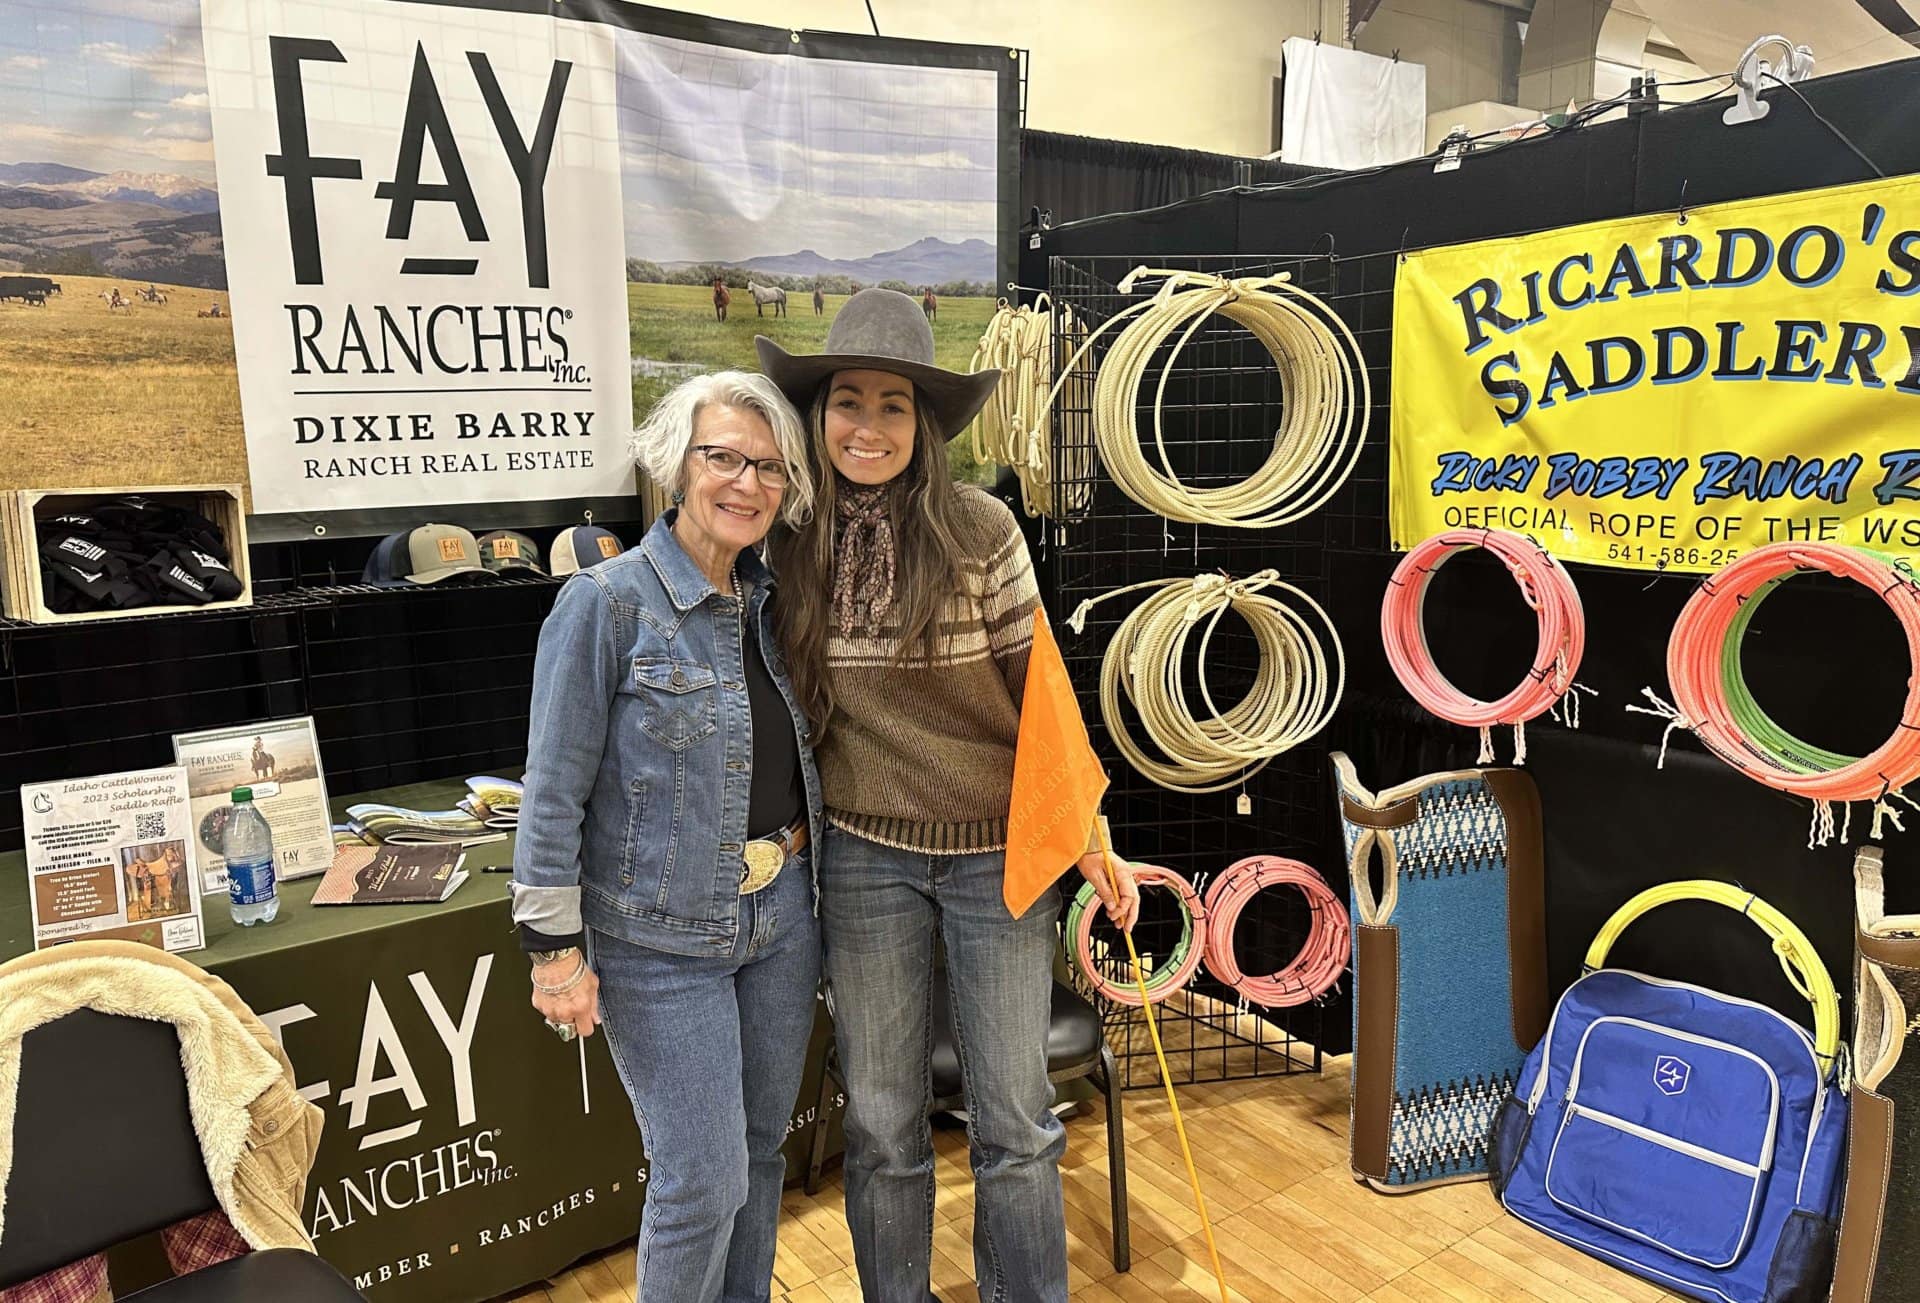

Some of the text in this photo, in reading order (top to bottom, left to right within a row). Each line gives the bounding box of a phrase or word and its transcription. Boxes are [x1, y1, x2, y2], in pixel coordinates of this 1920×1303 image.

[265, 35, 573, 289] FAY
[1453, 203, 1920, 355] RICARDO'S
[553, 359, 591, 384] Inc.
[293, 412, 595, 444] DIXIE BARRY
[304, 450, 594, 479] RANCH REAL ESTATE
[1544, 452, 1688, 500] BOBBY
[1694, 452, 1863, 504] RANCH
[1444, 506, 1920, 546] OFFICIAL ROPE OF THE WS
[443, 540, 459, 552] FAY
[499, 541, 513, 551] FAY
[63, 773, 176, 794] Idaho CattleWomen
[83, 785, 176, 804] 2023 Scholarship
[110, 795, 185, 813] Saddle Raffle
[283, 849, 300, 864] FAY
[482, 1165, 518, 1187] Inc.
[354, 1252, 432, 1291] MBER
[478, 1187, 596, 1246] RANCHES
